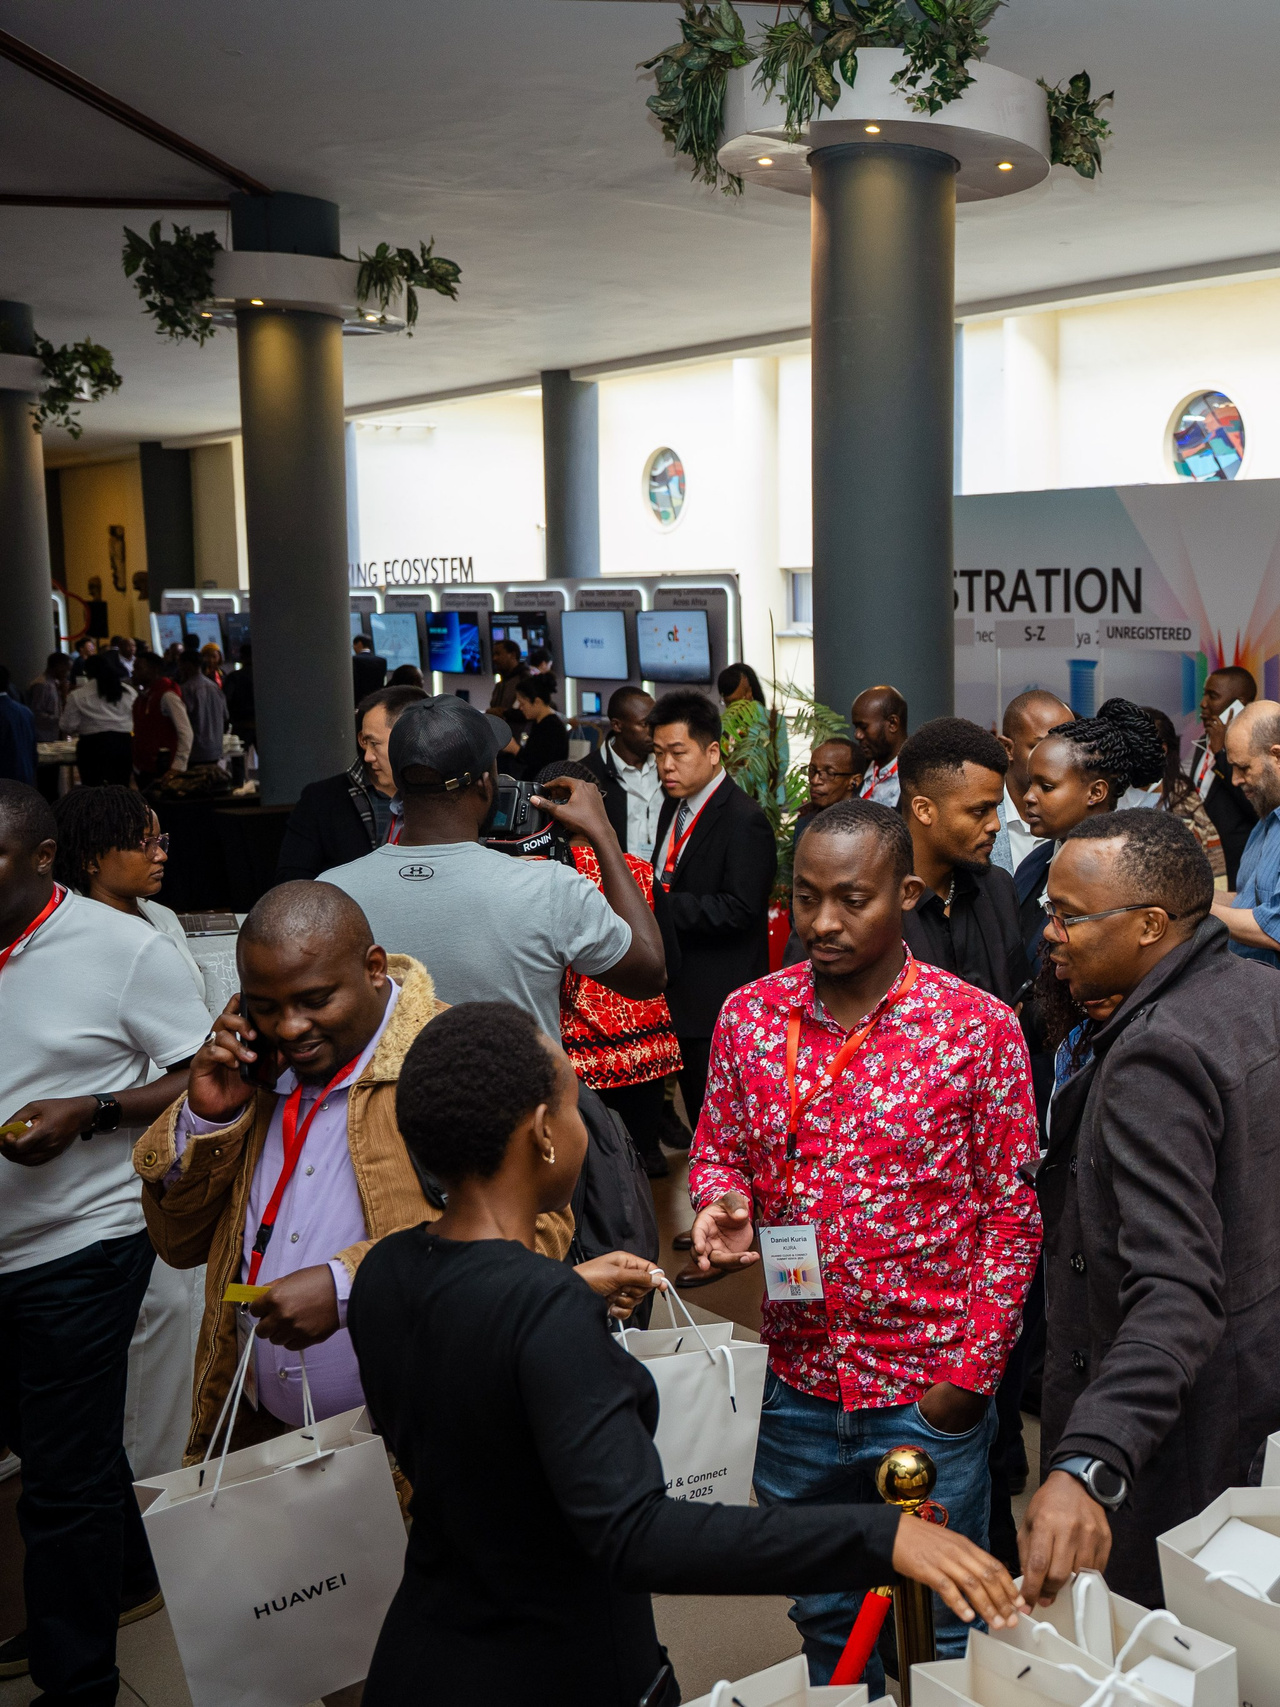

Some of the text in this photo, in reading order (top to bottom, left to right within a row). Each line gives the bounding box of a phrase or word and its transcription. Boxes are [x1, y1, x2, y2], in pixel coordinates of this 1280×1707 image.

[384, 556, 475, 585] ECOSYSTEM
[1024, 626, 1046, 642] S-Z
[1106, 626, 1192, 641] UNREGISTERED
[522, 832, 552, 853] RONIN
[676, 1477, 684, 1487] &
[687, 1467, 728, 1485] Connect
[689, 1485, 714, 1500] 2025
[254, 1572, 347, 1620] HUAWEI
